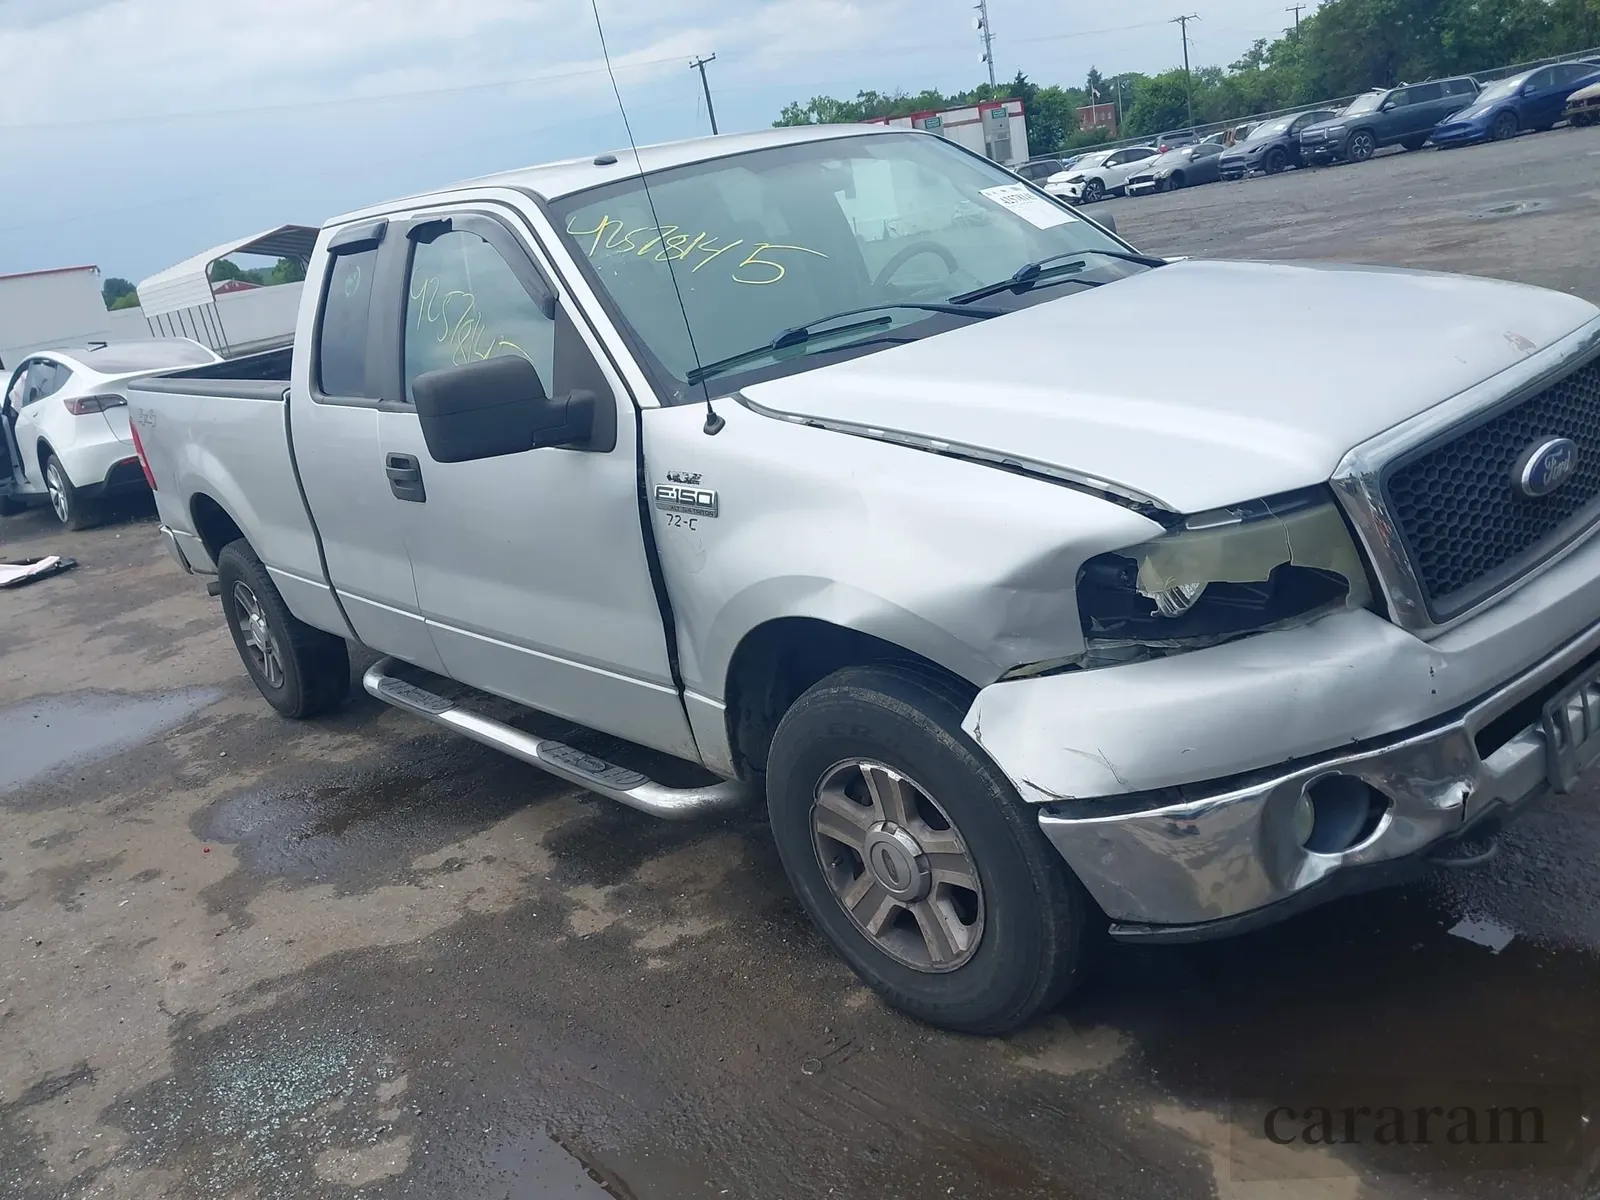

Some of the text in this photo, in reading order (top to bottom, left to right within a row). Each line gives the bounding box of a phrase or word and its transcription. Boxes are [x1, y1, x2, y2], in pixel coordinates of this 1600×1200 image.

[410, 267, 534, 366] 4257814
[1543, 448, 1571, 486] Ford
[655, 485, 713, 508] F-150
[666, 513, 698, 531] 72-C
